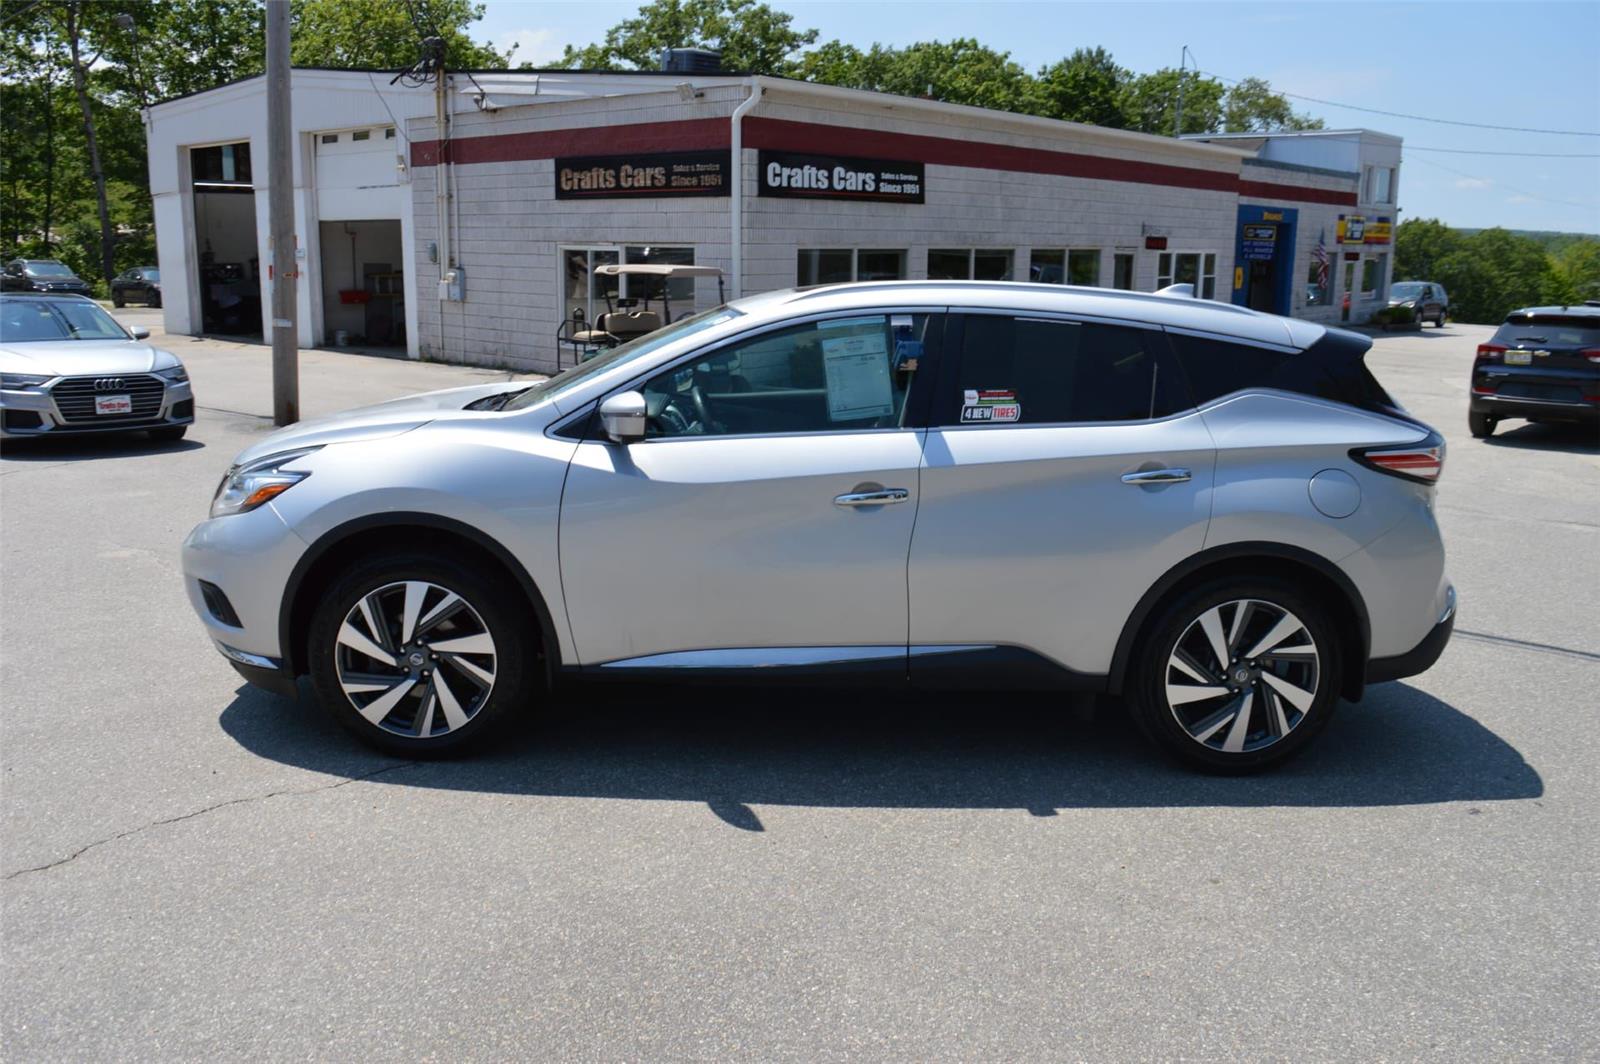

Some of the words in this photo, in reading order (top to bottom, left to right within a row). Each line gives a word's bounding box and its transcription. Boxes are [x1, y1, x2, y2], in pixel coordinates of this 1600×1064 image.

[560, 167, 616, 191] Crafts
[620, 164, 666, 189] Cars
[671, 175, 698, 186] Since
[700, 174, 722, 186] 1951
[767, 161, 829, 189] Crafts
[832, 166, 876, 192] Cars
[879, 182, 902, 193] Since
[903, 183, 920, 194] 1951
[965, 408, 972, 419] 4
[972, 408, 992, 419] NEW
[993, 408, 1016, 418] TIRES
